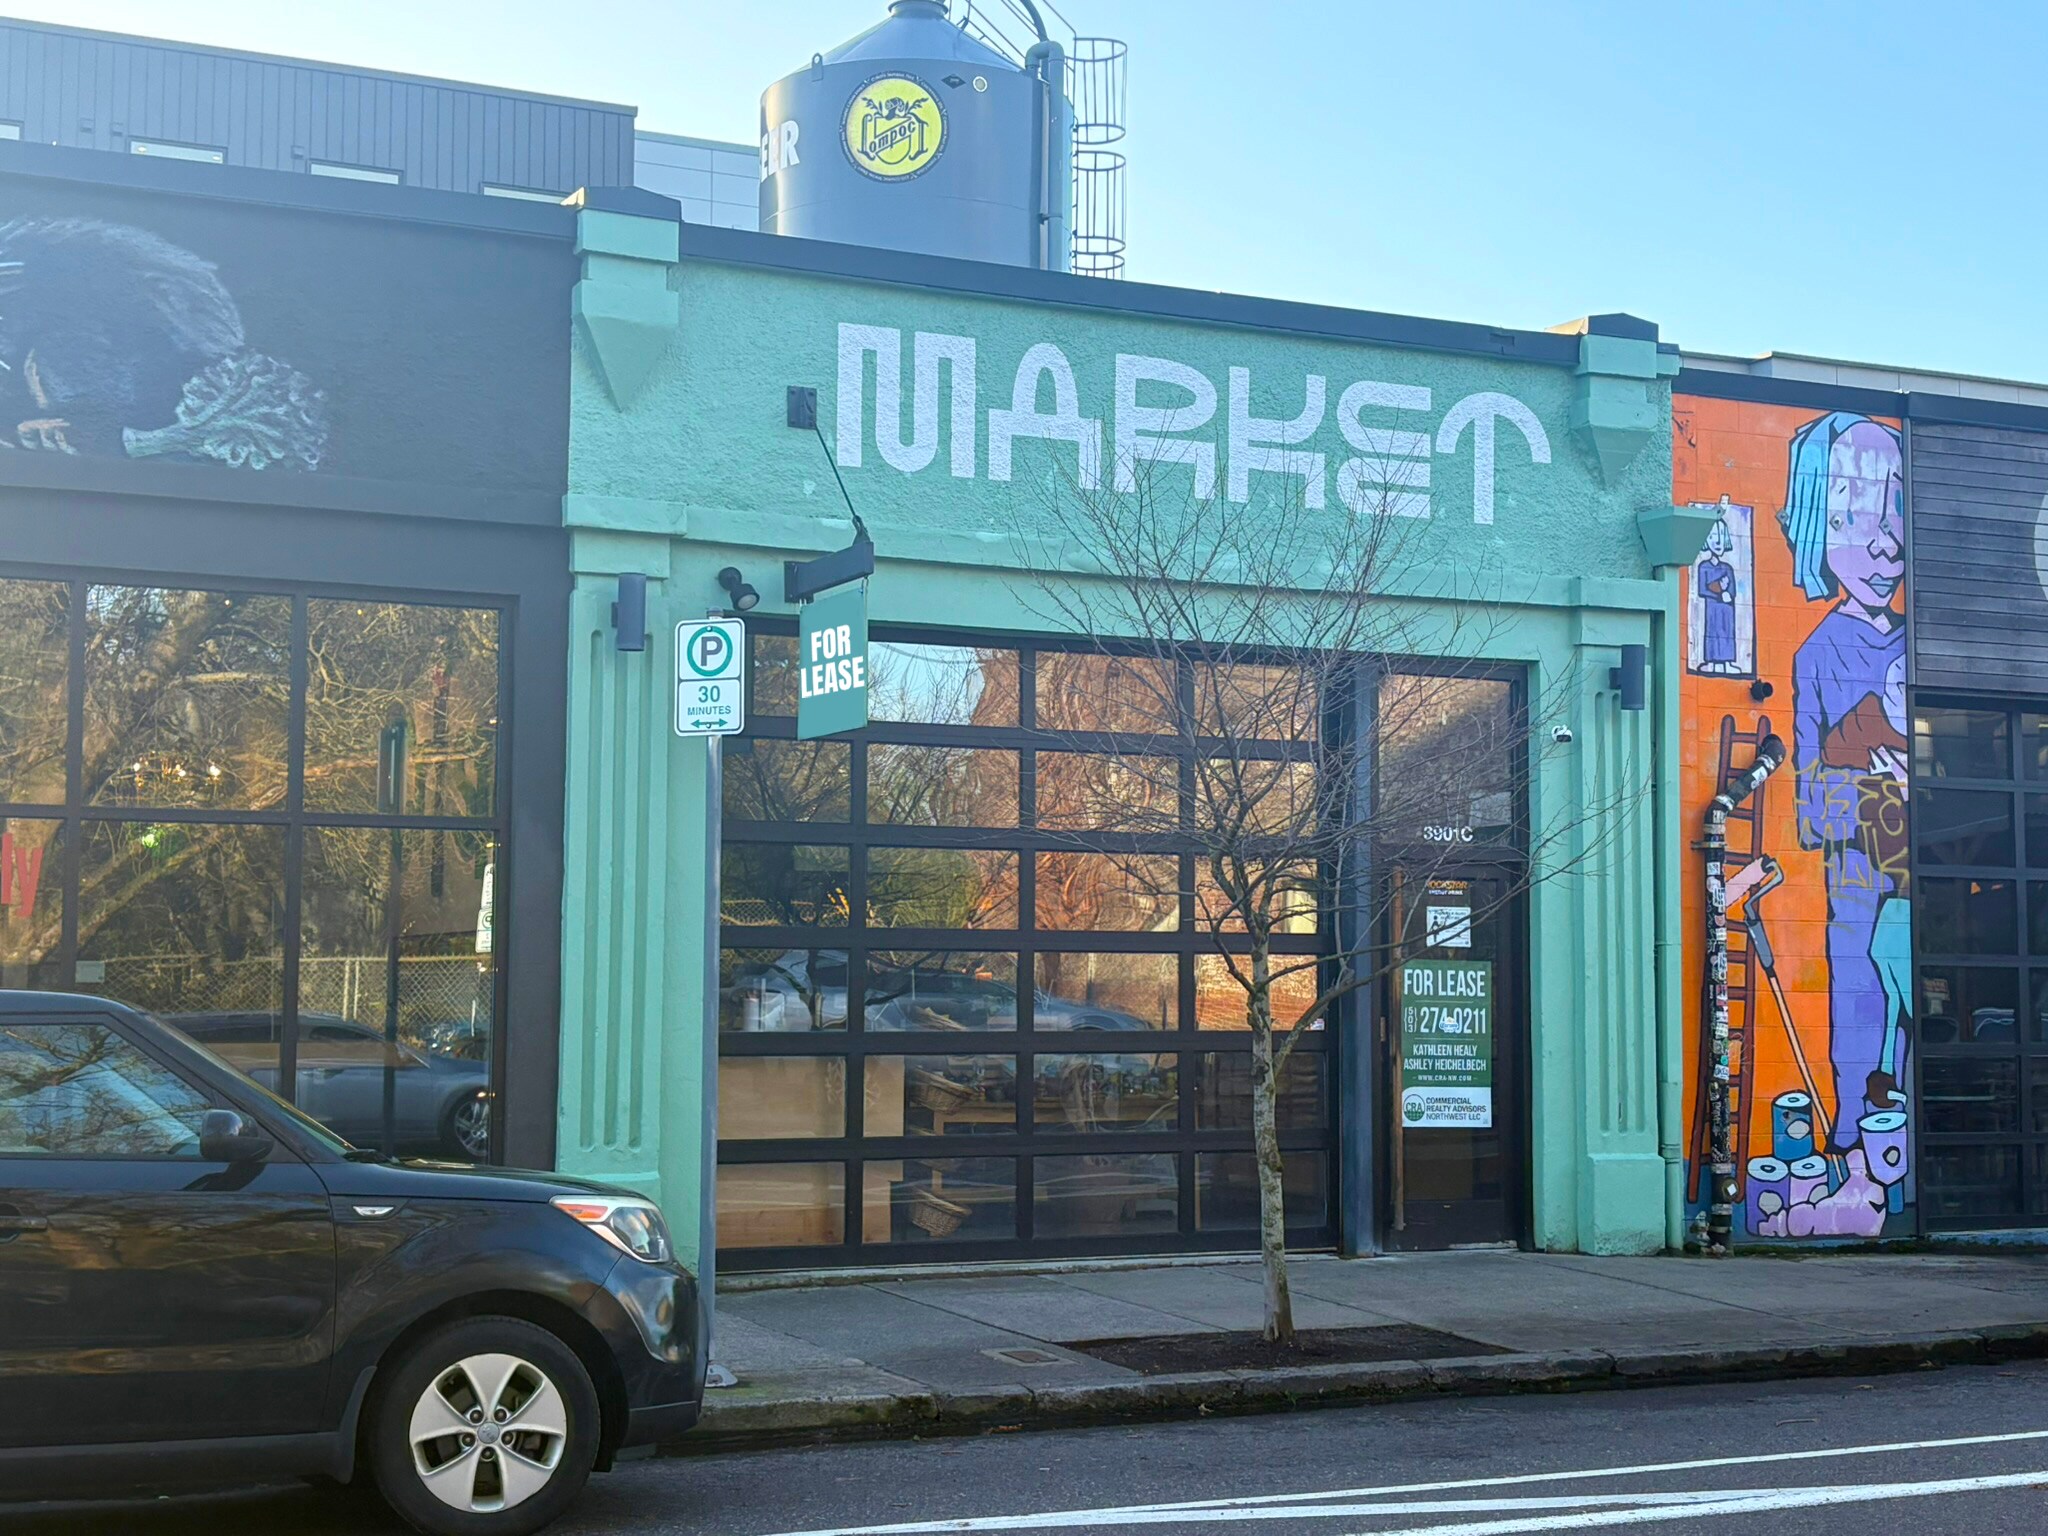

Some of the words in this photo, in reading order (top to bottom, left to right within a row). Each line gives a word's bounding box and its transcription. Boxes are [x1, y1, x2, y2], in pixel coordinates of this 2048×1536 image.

[836, 322, 1551, 525] MARKET
[700, 636, 723, 666] P
[811, 624, 851, 662] FOR
[801, 656, 865, 699] LEASE
[698, 686, 721, 703] 30
[687, 705, 732, 716] MINUTES
[1423, 826, 1474, 842] 3901C
[1403, 969, 1434, 996] FOR
[1438, 970, 1486, 997] LEASE
[1420, 1006, 1486, 1034] 2740211
[1413, 1044, 1453, 1056] KATHLEEN
[1453, 1045, 1478, 1056] HEALY
[1403, 1058, 1434, 1070] ASHLEY
[1434, 1059, 1487, 1071] HEICHELBECH
[1405, 1102, 1423, 1112] CRA
[1425, 1097, 1472, 1105] COMMERCIAL
[1452, 1105, 1487, 1113] ADVISORS
[1468, 1113, 1481, 1121] LLC
